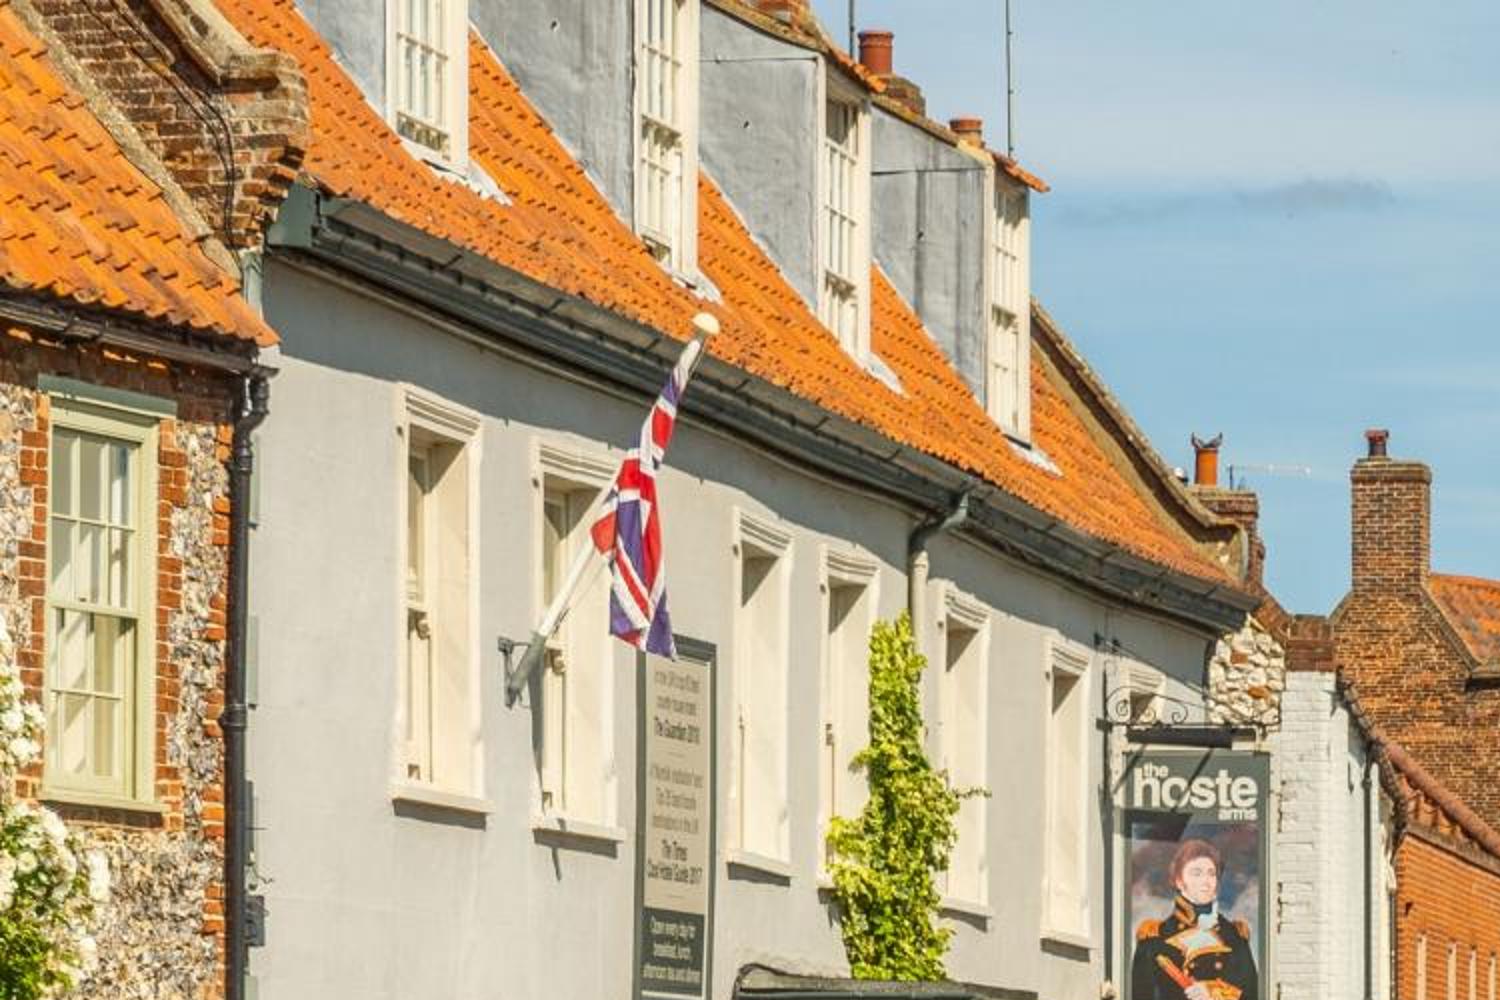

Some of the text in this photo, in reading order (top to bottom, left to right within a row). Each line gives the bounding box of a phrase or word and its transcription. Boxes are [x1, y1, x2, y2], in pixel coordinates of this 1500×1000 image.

[1143, 762, 1169, 778] the
[1133, 767, 1258, 809] hoste
[1217, 809, 1258, 821] arms
